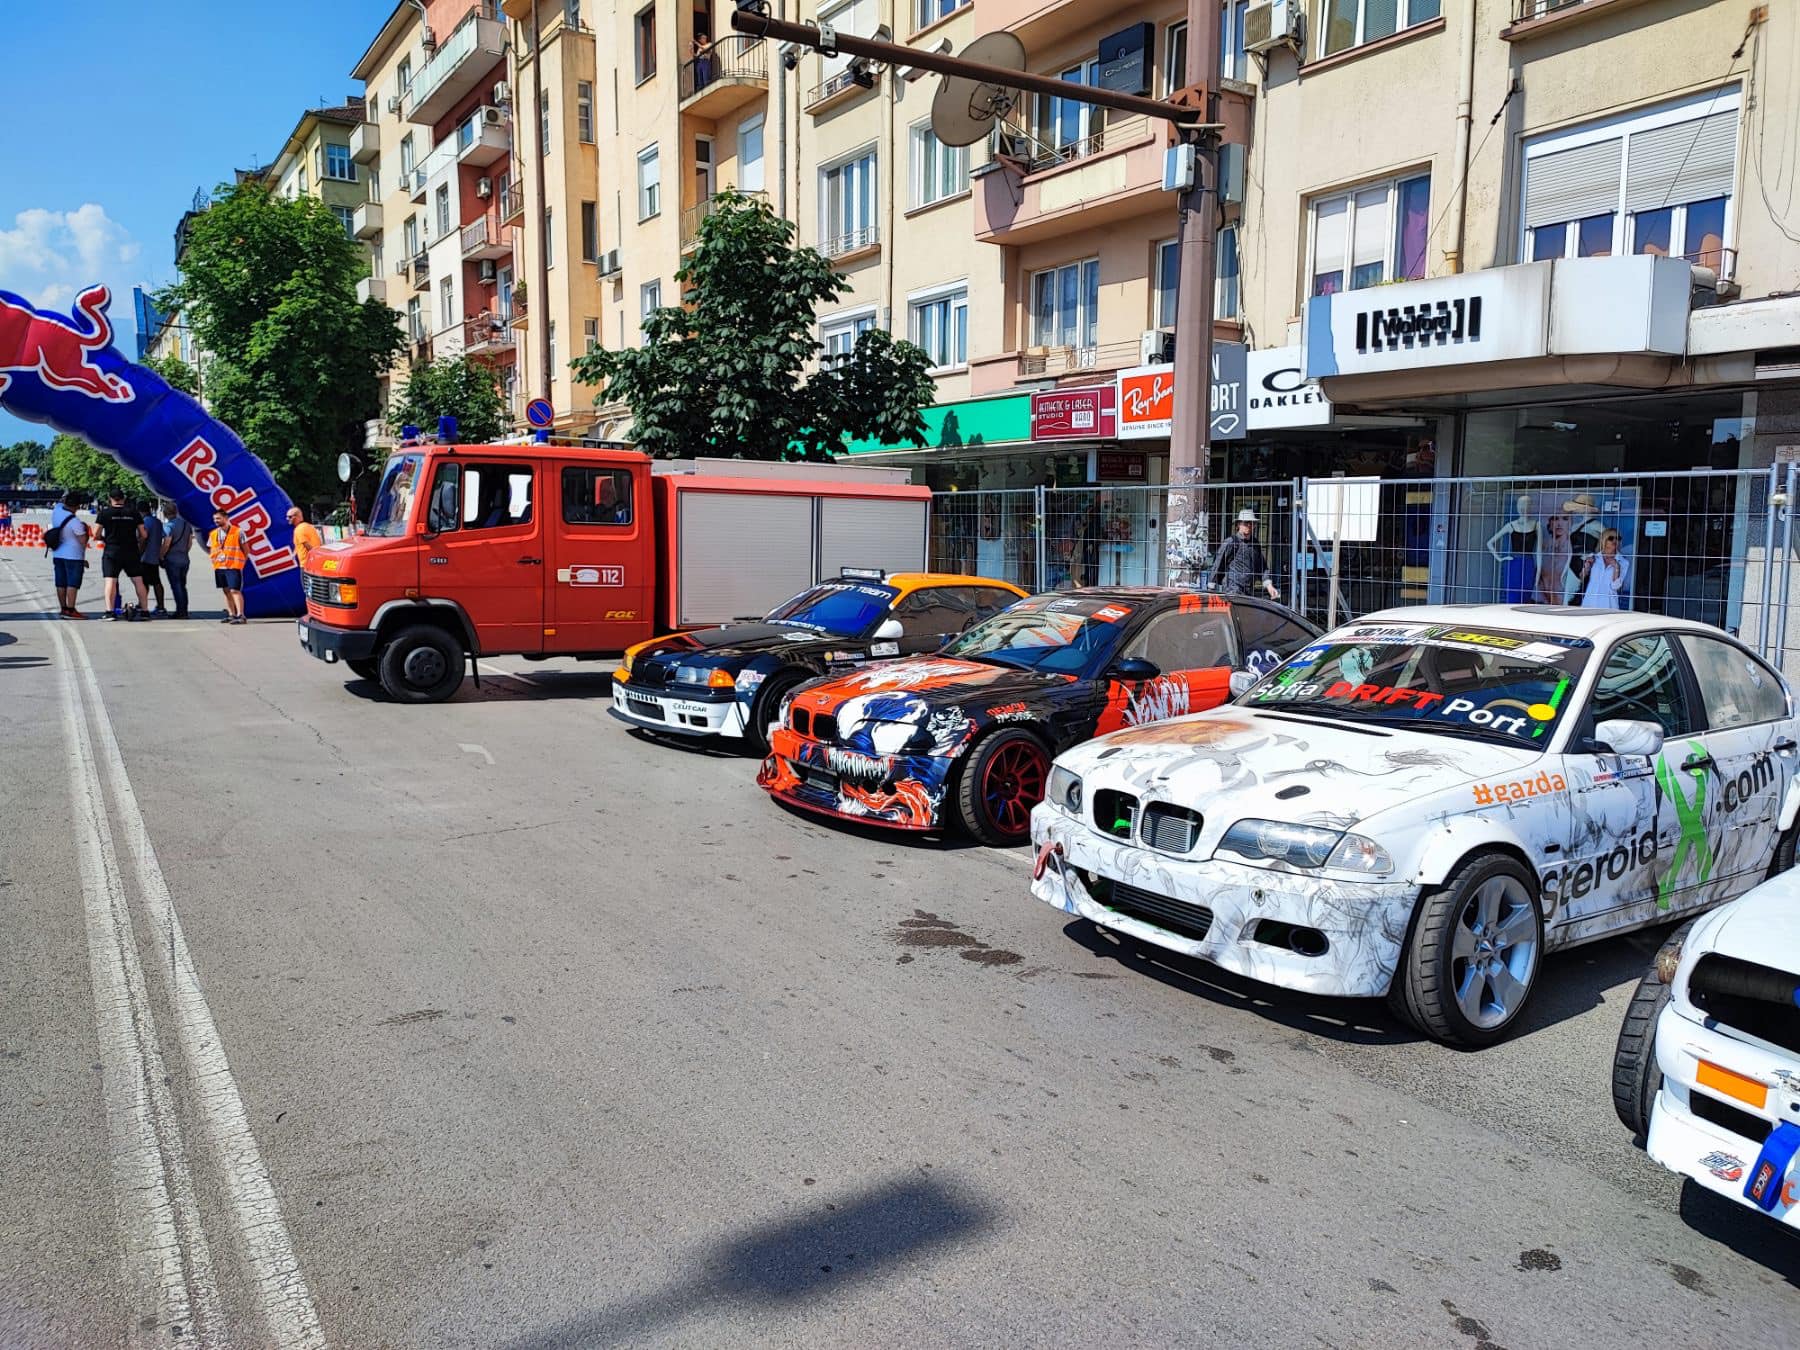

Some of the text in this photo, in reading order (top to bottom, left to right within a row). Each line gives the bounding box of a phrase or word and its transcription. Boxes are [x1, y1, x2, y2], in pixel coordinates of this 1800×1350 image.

[1382, 310, 1451, 337] Wolford
[1124, 377, 1174, 416] Ray-Ban
[1039, 412, 1063, 420] STUDIO
[171, 436, 256, 512] Red
[229, 502, 297, 578] Bull
[602, 569, 619, 583] 112
[1251, 681, 1527, 735] Sofia DRIFT Port
[1472, 770, 1567, 805] #gazda
